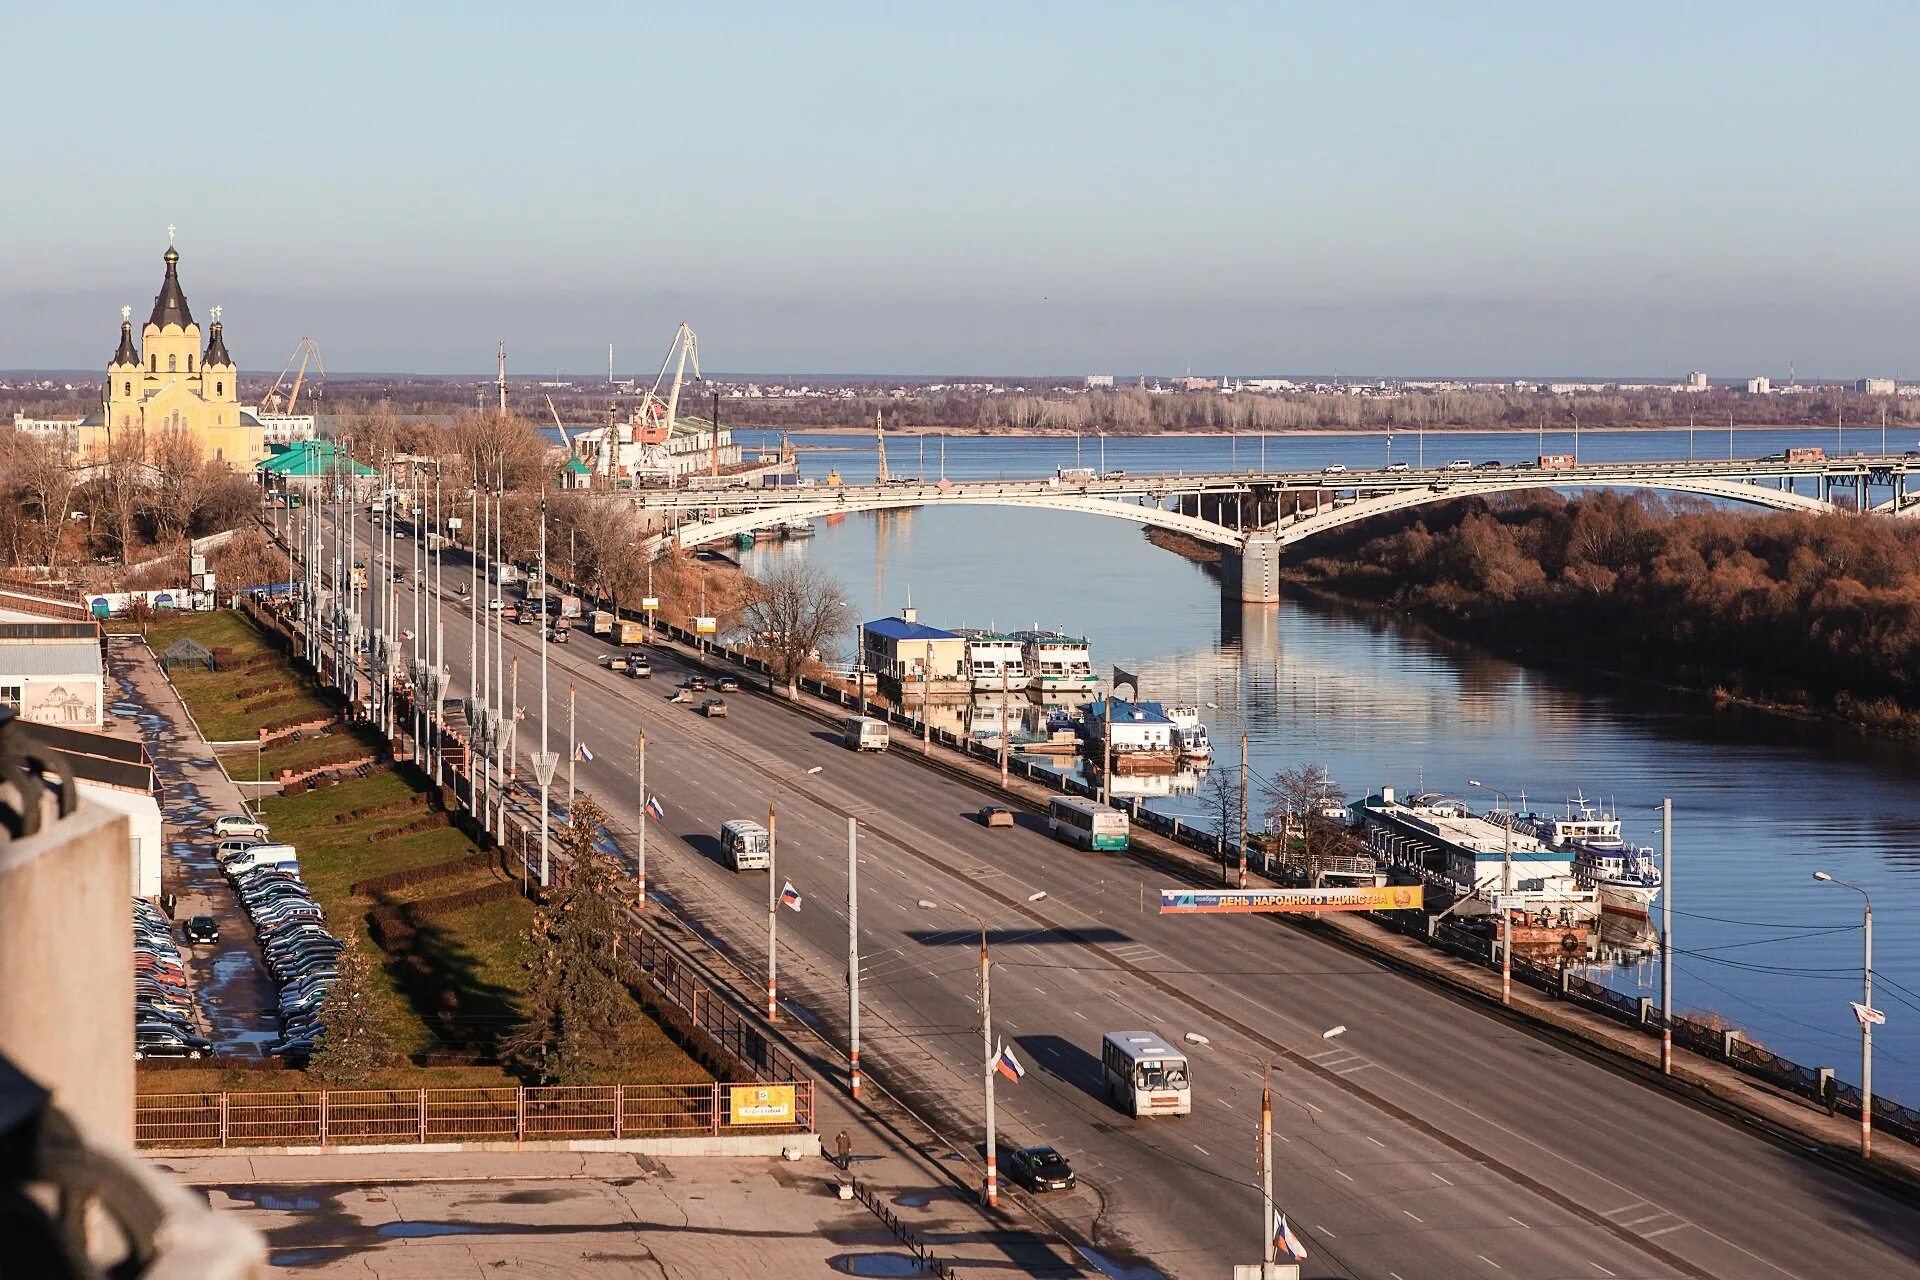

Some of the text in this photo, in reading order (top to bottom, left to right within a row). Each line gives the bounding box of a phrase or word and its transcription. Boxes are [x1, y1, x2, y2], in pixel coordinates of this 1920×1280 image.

[1218, 896, 1250, 907] ДЕНЬ
[1253, 895, 1322, 906] НАРОДНОГО
[1326, 894, 1387, 906] ЕДИНСТВА
